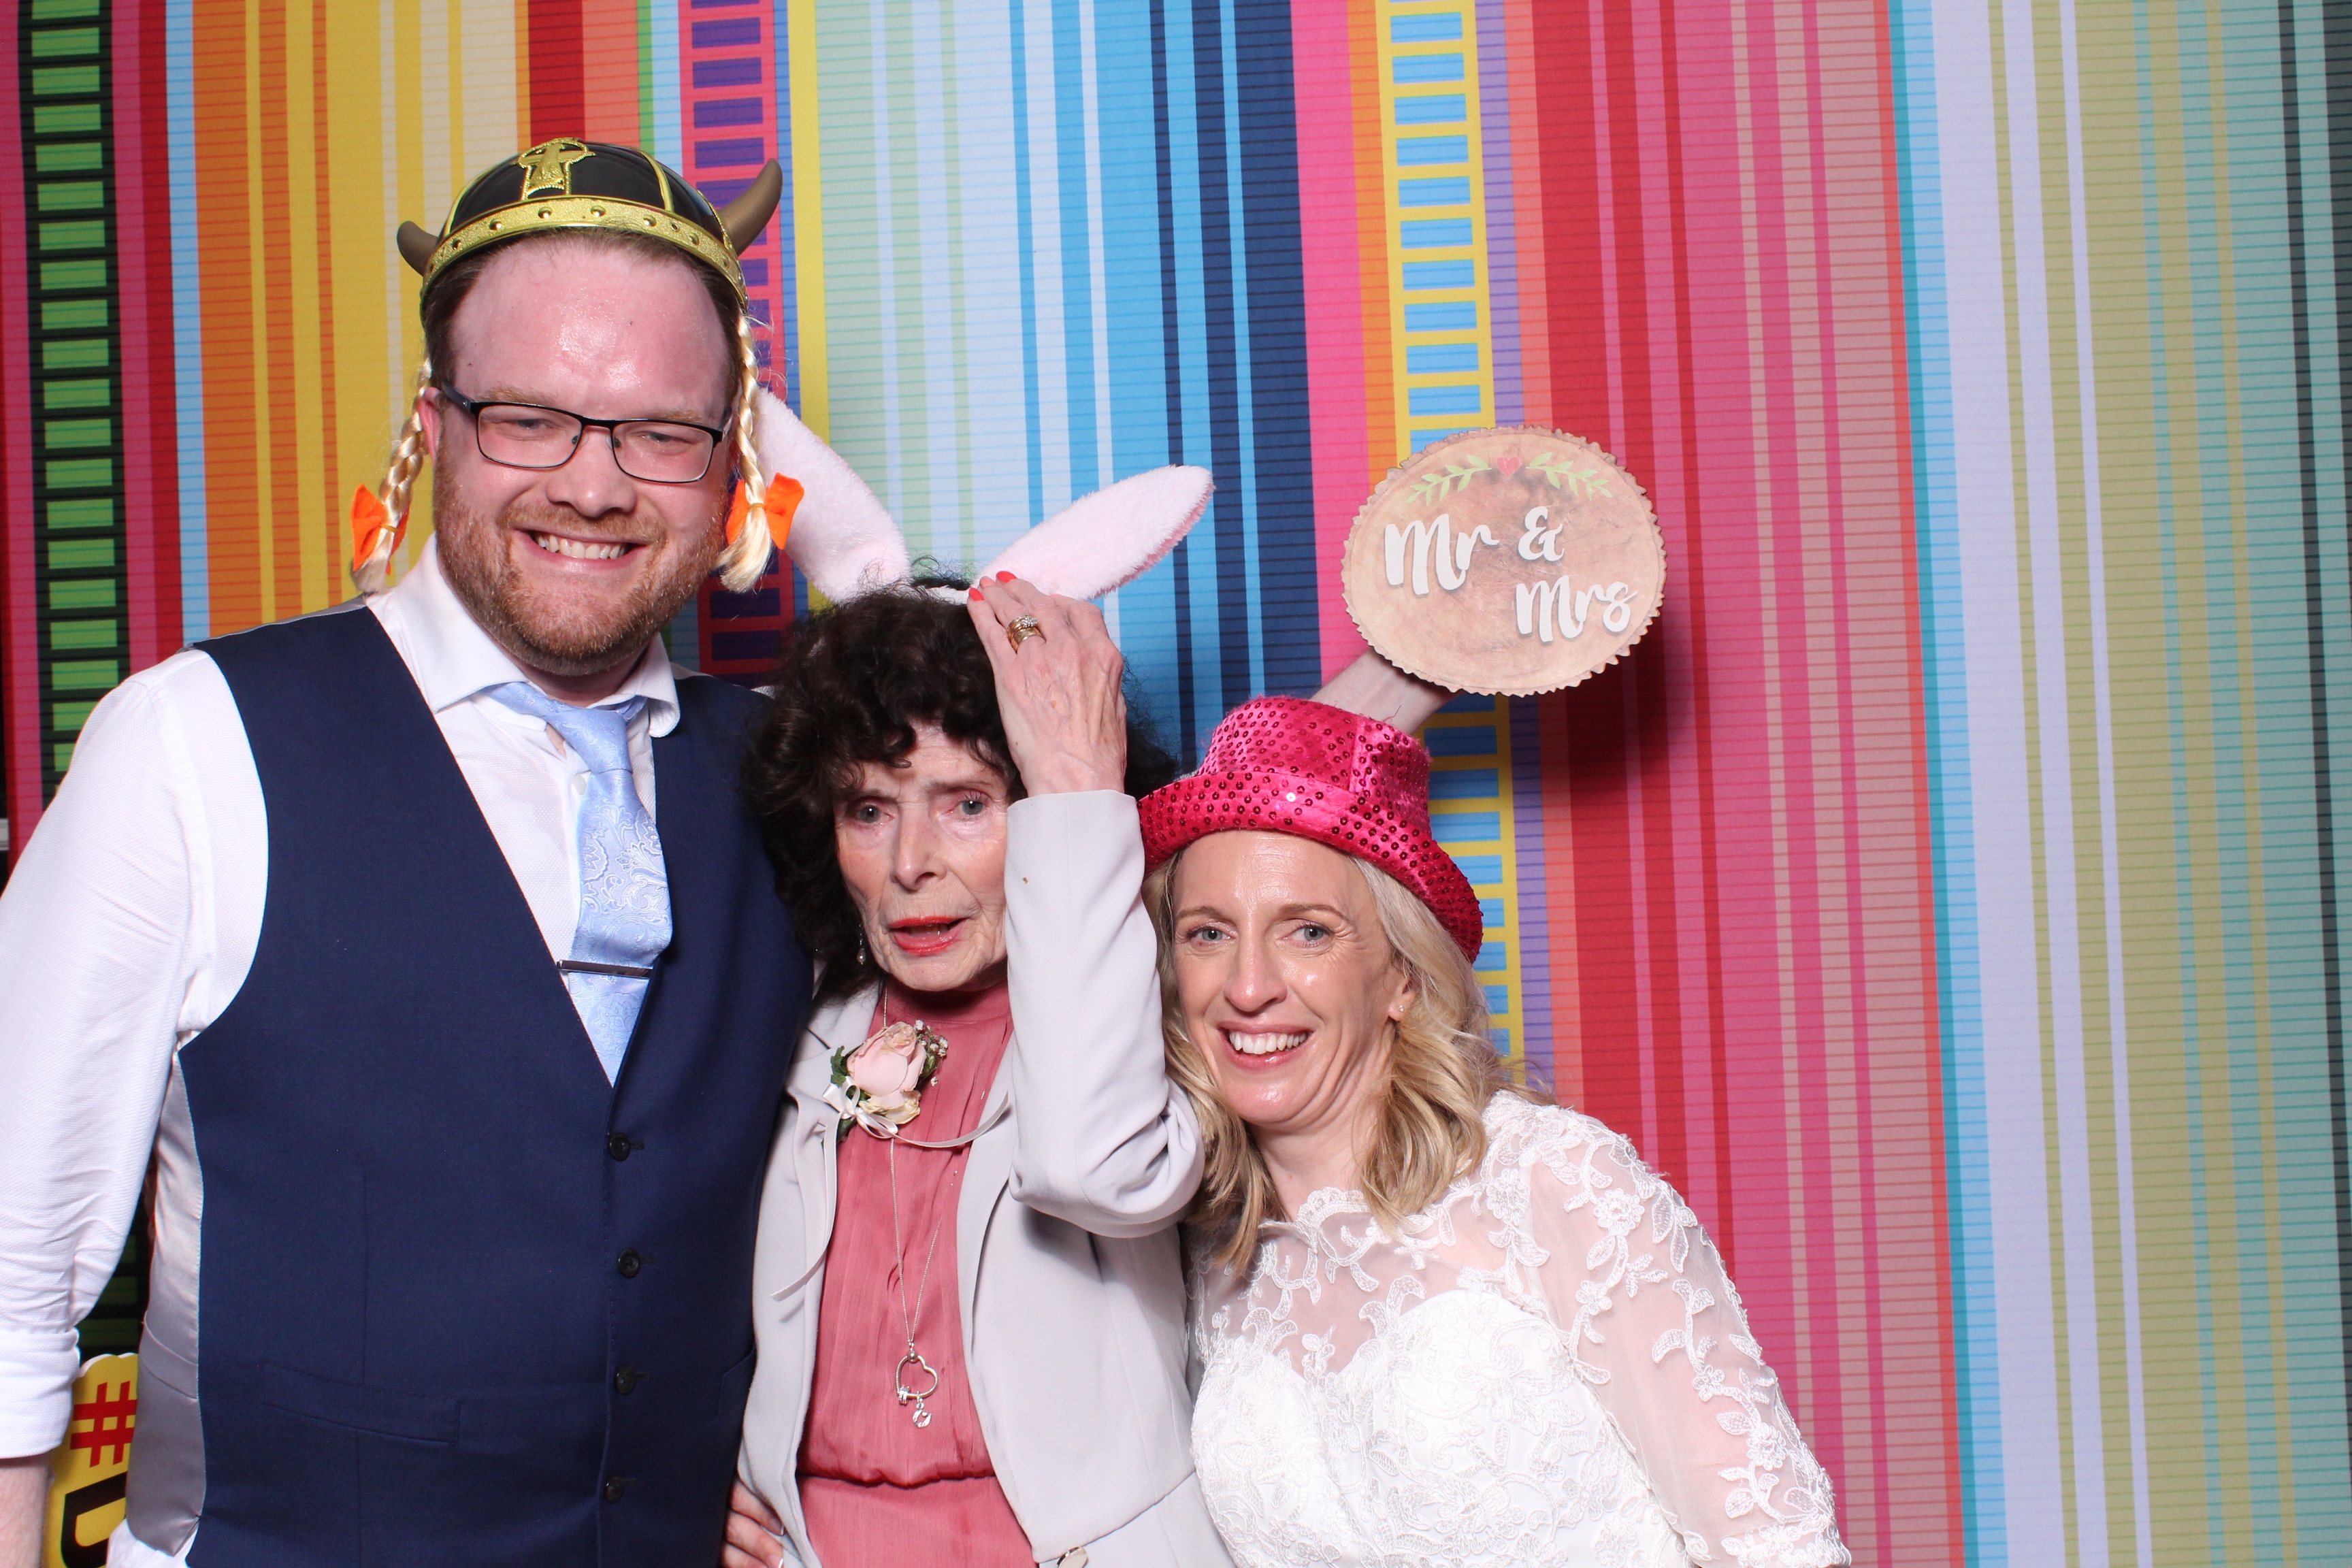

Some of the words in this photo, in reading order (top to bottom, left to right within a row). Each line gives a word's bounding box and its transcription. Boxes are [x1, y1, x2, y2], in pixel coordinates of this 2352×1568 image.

[1384, 514, 1499, 595] Mr
[1517, 506, 1564, 561] &
[1516, 575, 1637, 642] Mrs
